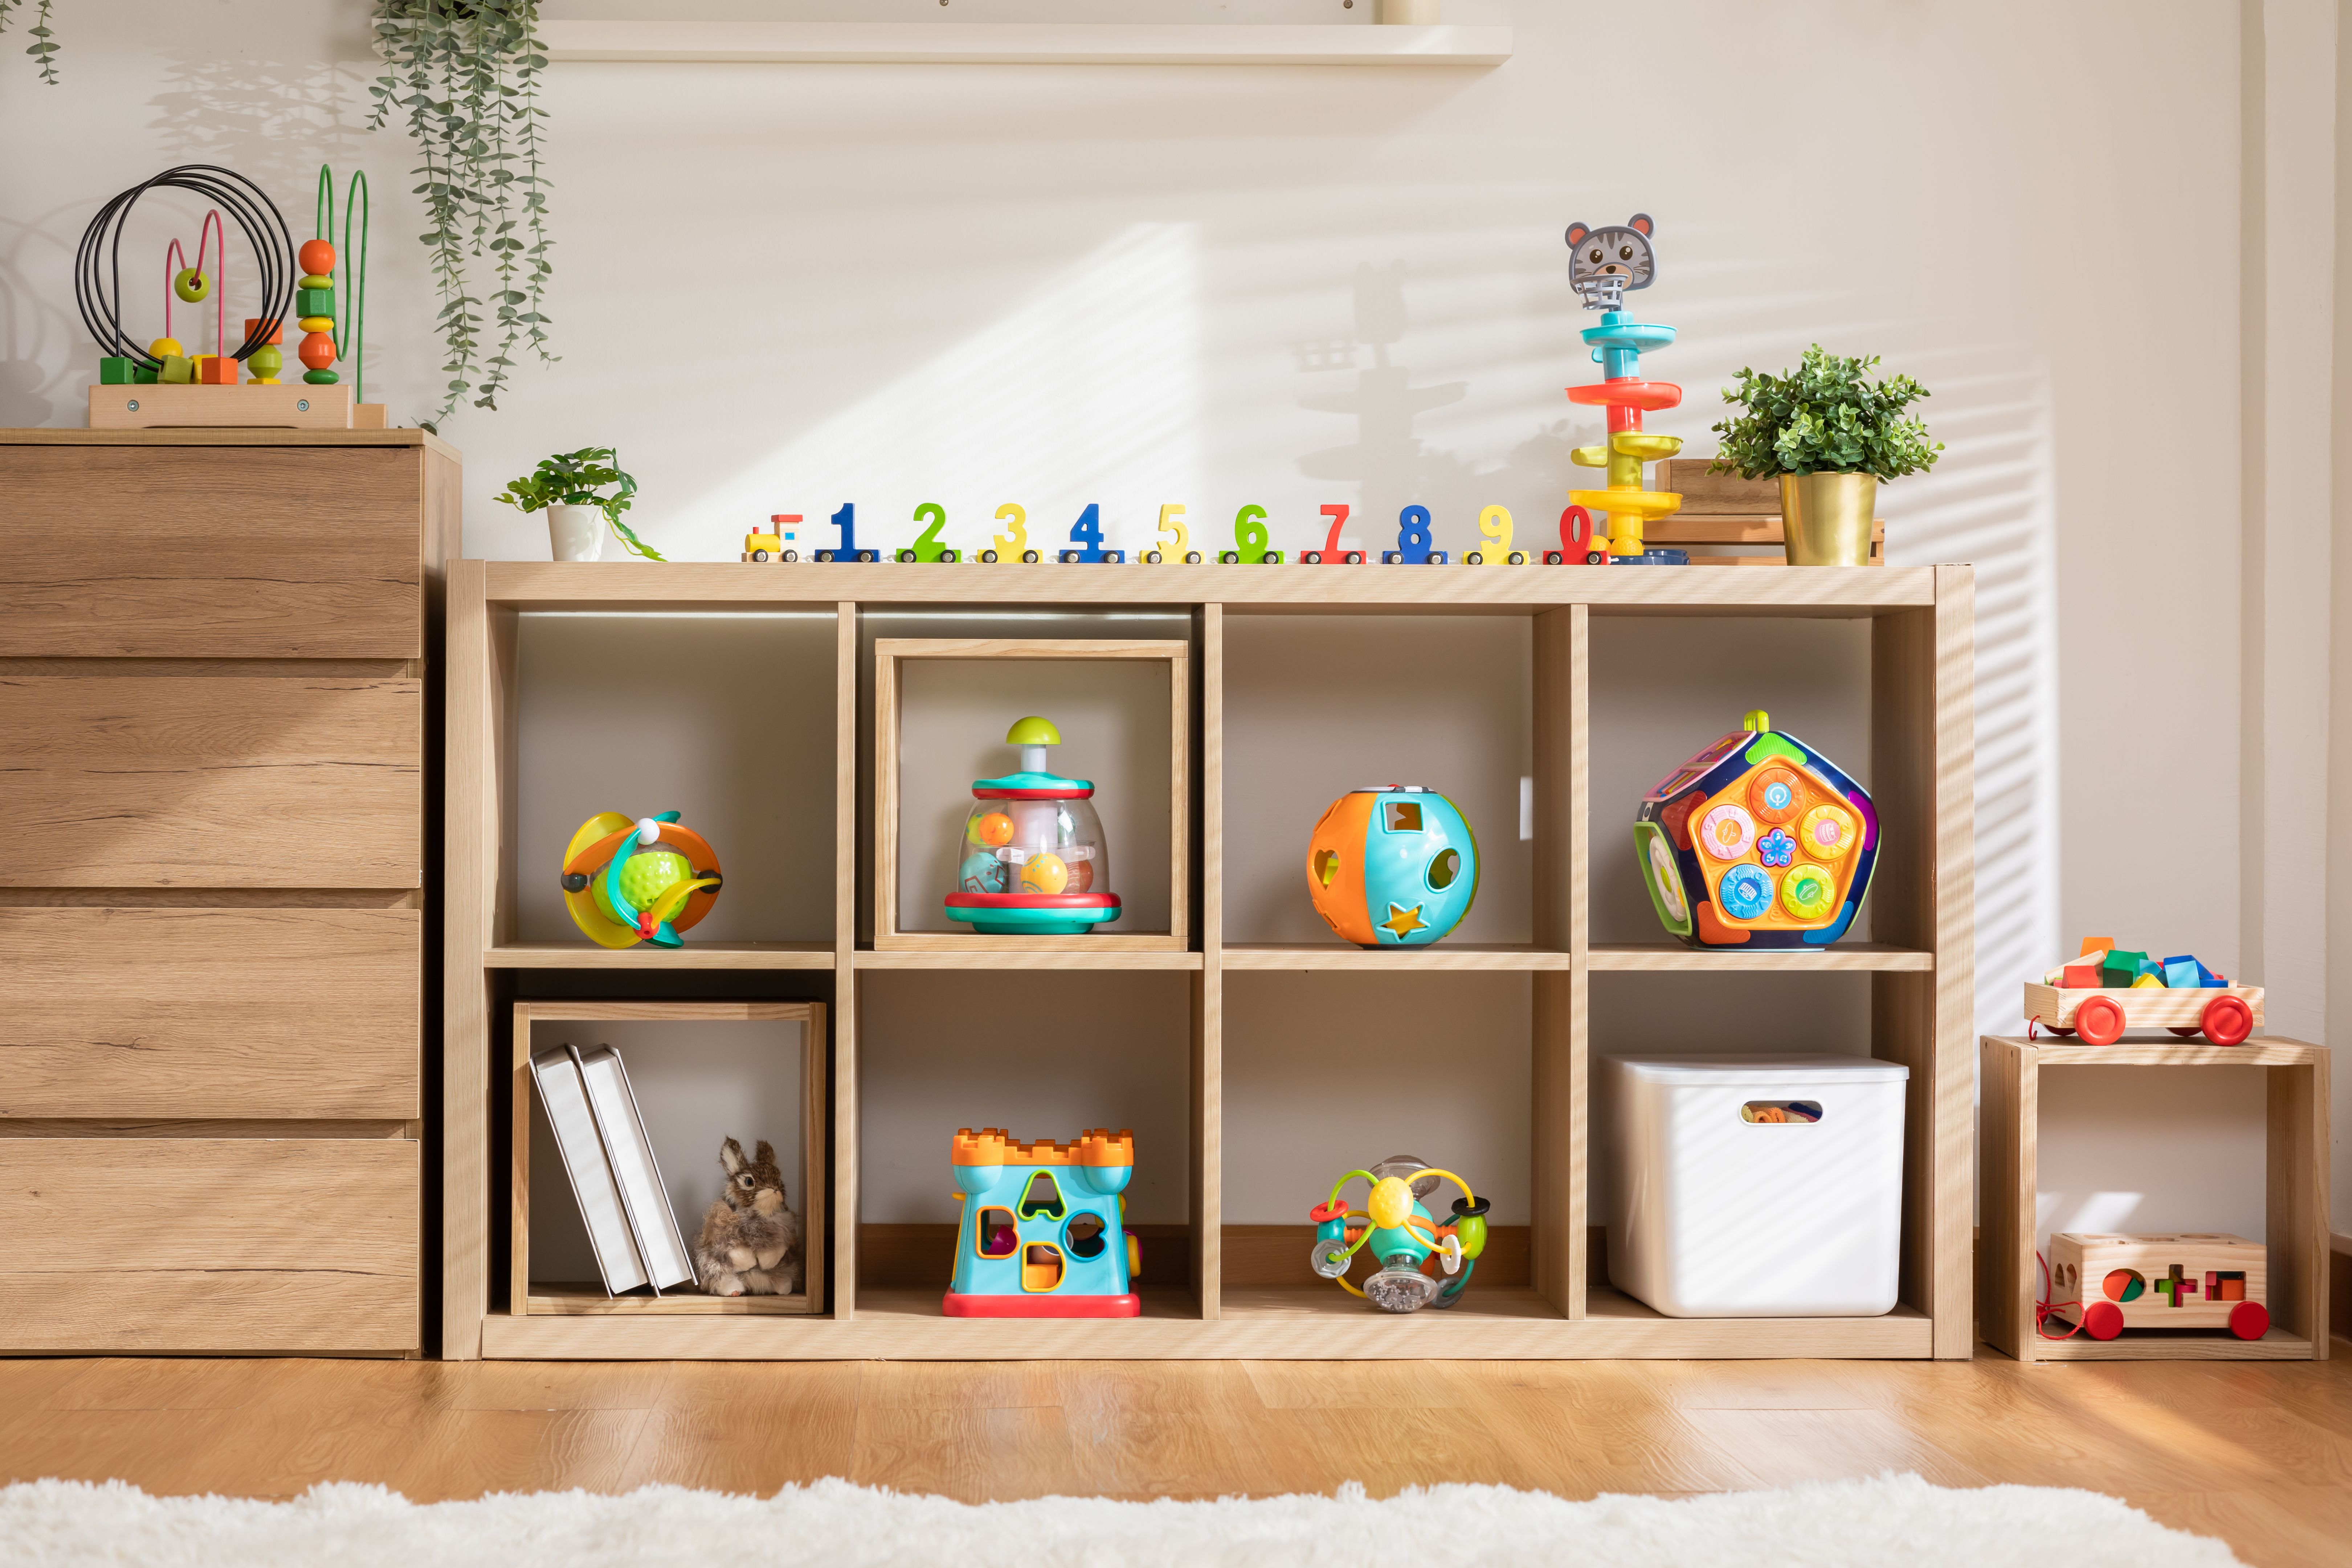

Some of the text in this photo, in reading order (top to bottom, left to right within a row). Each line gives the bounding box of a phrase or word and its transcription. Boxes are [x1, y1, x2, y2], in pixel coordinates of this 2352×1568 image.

[831, 503, 1594, 552] 1 2 3 4 5 6 7 8 9 0
[1773, 811, 1783, 821] A
[1742, 834, 1751, 843] E
[1803, 834, 1813, 843] B
[1754, 871, 1763, 881] D
[1788, 898, 1797, 908] C
[1017, 1169, 1068, 1221] A
[976, 1205, 1021, 1259] B
[1061, 1209, 1109, 1262] C
[1022, 1241, 1067, 1293] D
